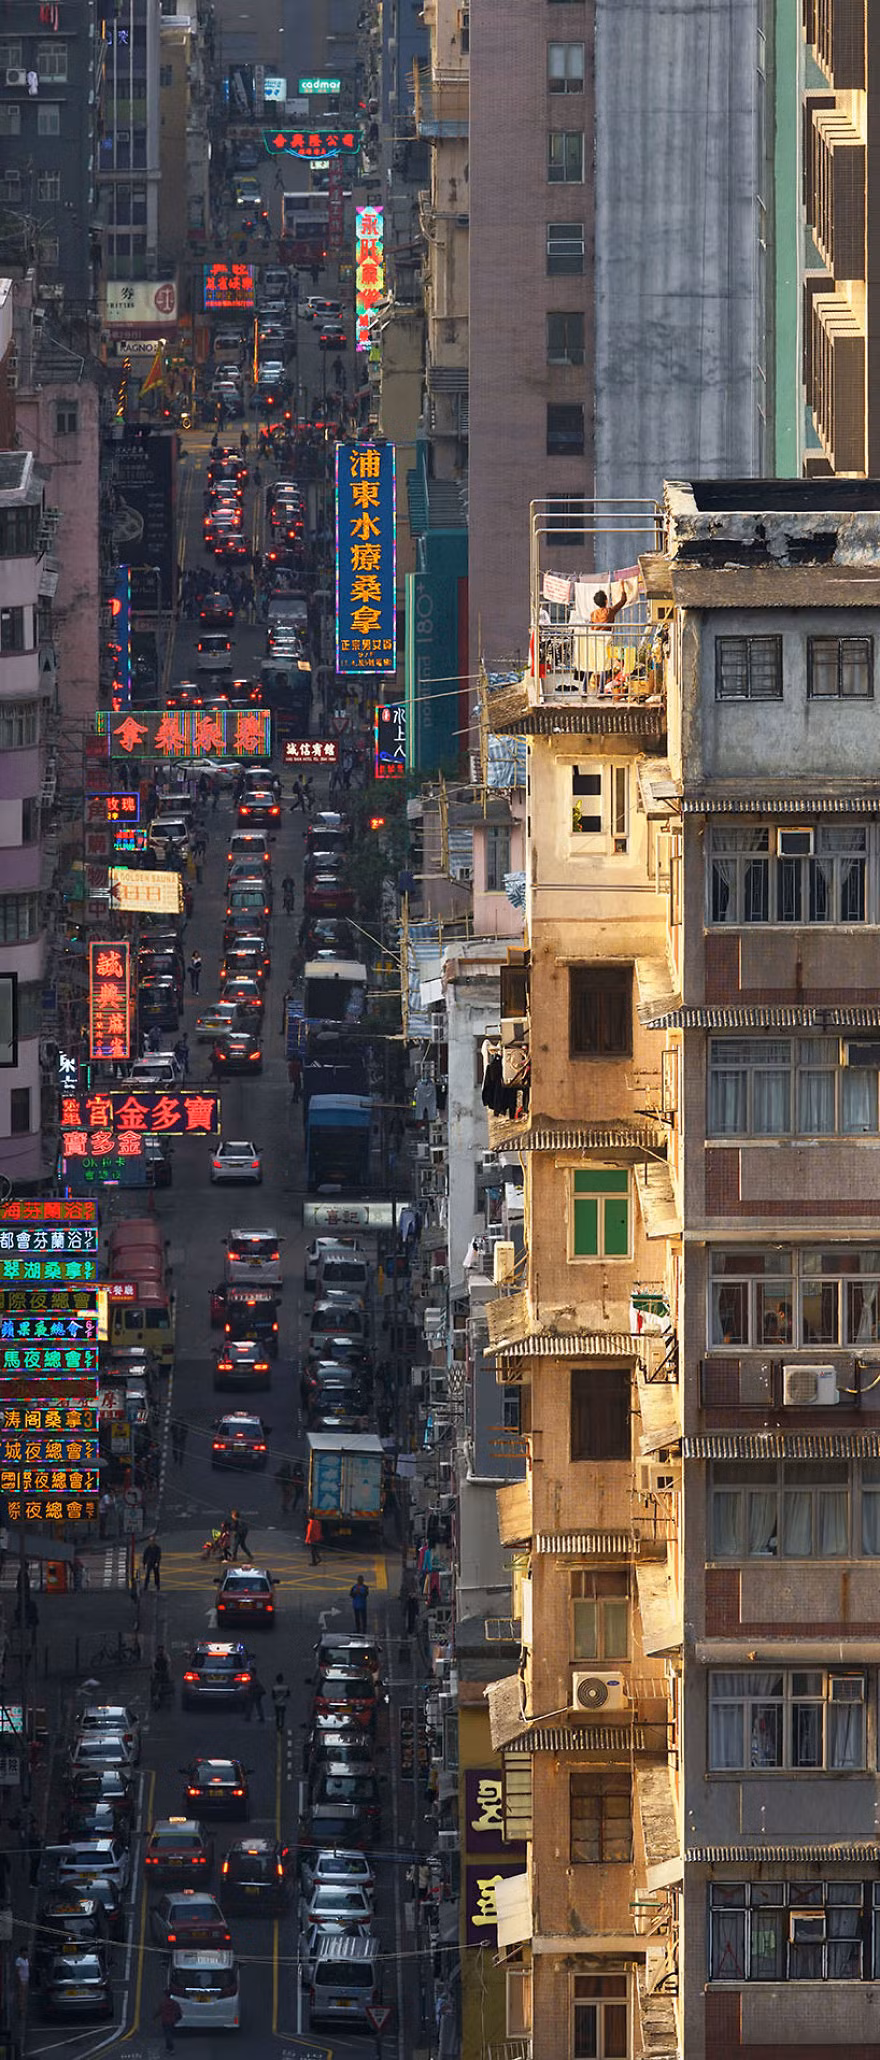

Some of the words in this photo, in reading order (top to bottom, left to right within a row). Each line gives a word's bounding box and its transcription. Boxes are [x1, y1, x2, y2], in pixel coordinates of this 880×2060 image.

[350, 449, 383, 635] 浦東水療桑拿
[3, 1261, 83, 1279] 翠湖桑拿
